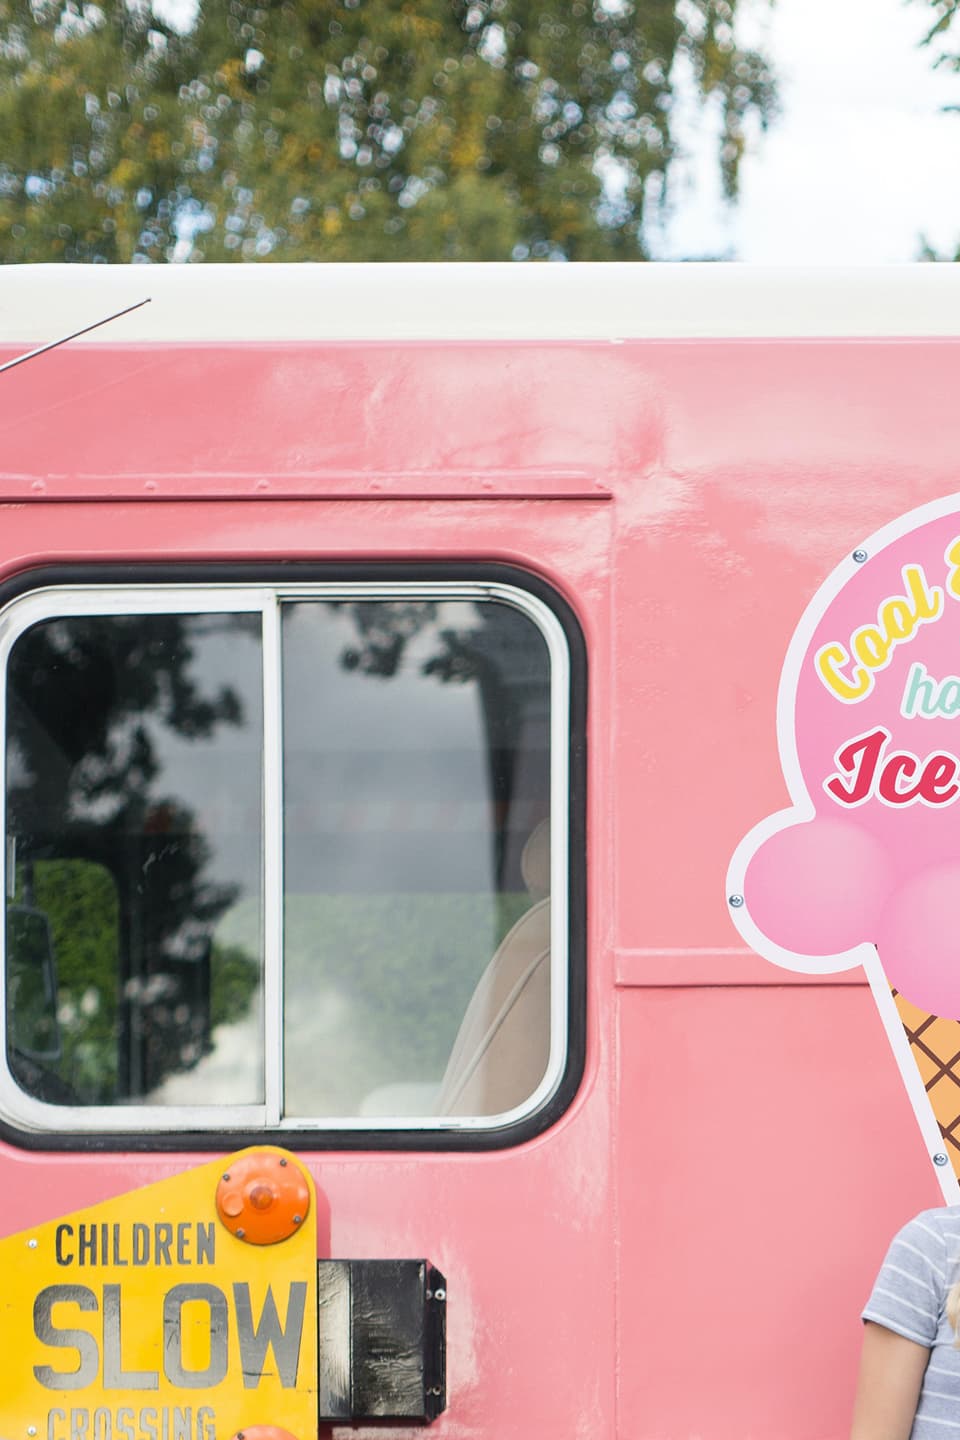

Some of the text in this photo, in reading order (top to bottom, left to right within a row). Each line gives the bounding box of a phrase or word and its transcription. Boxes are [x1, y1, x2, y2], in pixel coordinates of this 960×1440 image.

[818, 569, 939, 700] Cool
[828, 731, 958, 803] Ice
[55, 1223, 216, 1266] CHILDREN
[33, 1281, 308, 1390] SLOW
